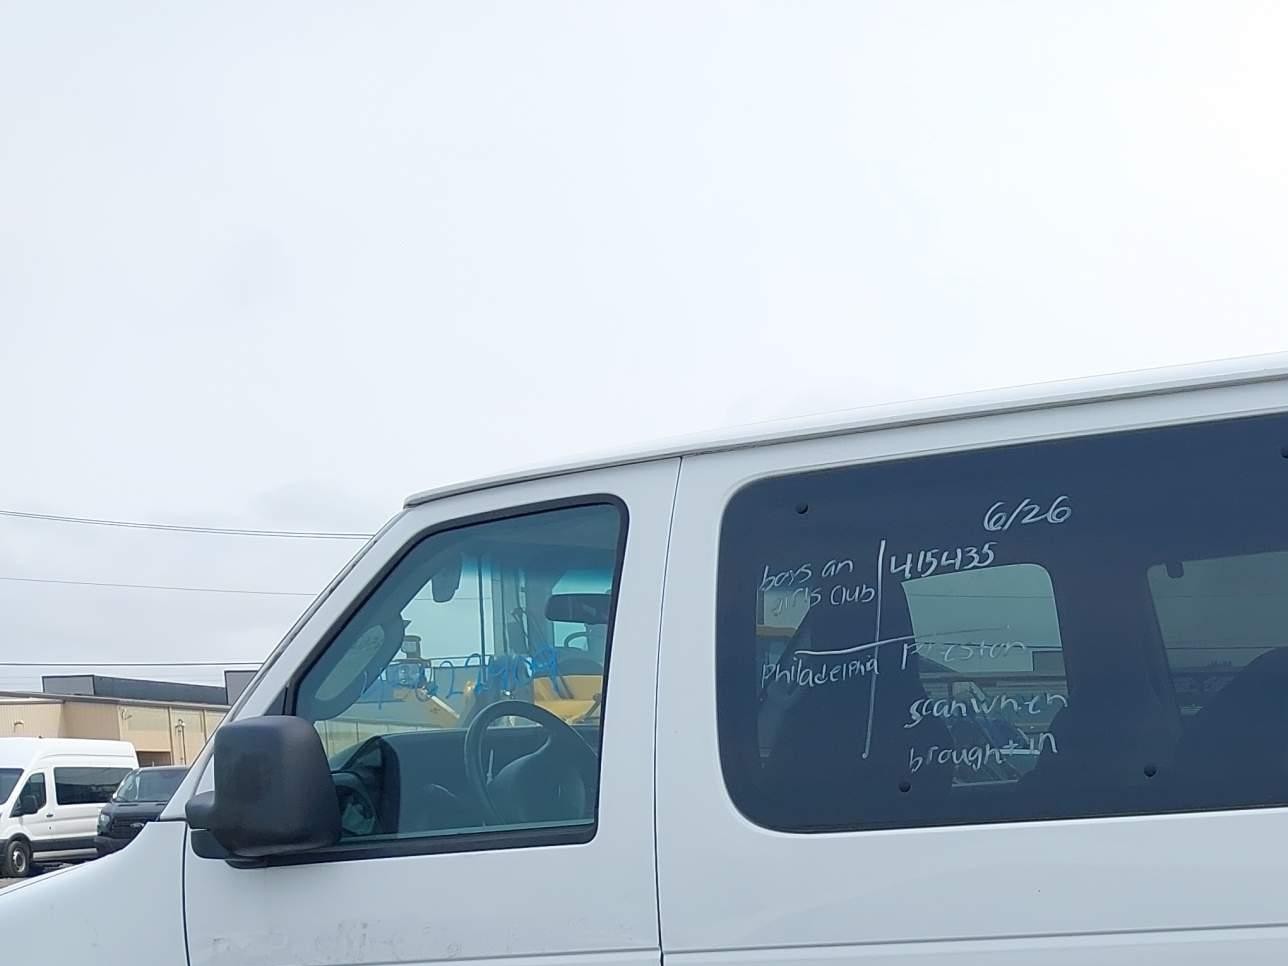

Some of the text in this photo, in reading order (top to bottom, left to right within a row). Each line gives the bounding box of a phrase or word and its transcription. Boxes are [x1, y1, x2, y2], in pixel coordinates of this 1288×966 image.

[983, 495, 1073, 532] 6/26
[760, 558, 855, 592] boys an
[889, 541, 999, 579] 415435
